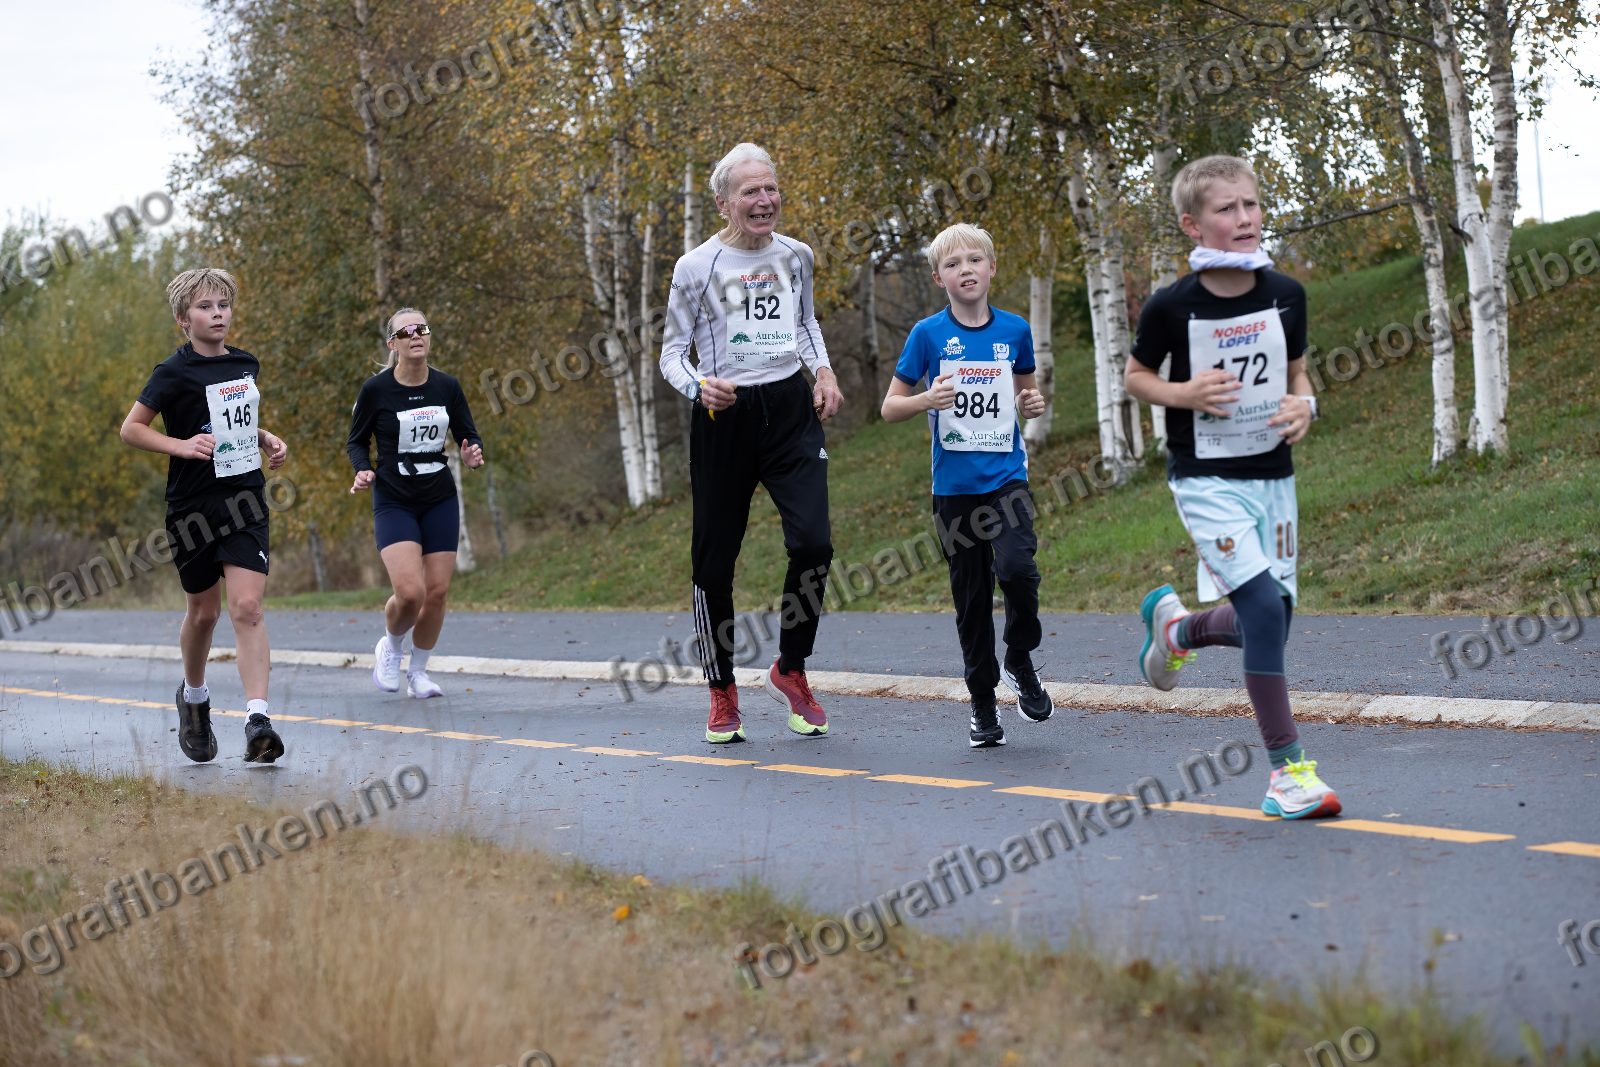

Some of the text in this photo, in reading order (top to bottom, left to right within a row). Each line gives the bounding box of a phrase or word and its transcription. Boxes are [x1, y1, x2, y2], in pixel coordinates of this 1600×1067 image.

[739, 273, 779, 282] NORGES
[743, 281, 773, 290] LØPET
[741, 295, 780, 320] 152
[1213, 320, 1267, 339] NORGES
[755, 330, 793, 342] Aurskog
[1218, 333, 1260, 349] LØPET
[956, 367, 1002, 377] NORGES
[961, 376, 995, 385] LØPET
[219, 384, 249, 395] NORGES
[223, 391, 246, 402] LØPET
[953, 391, 1000, 419] 984
[1236, 400, 1281, 417] Aursko
[222, 403, 251, 430] 146
[411, 425, 439, 442] 170
[969, 430, 1011, 442] Aurskog
